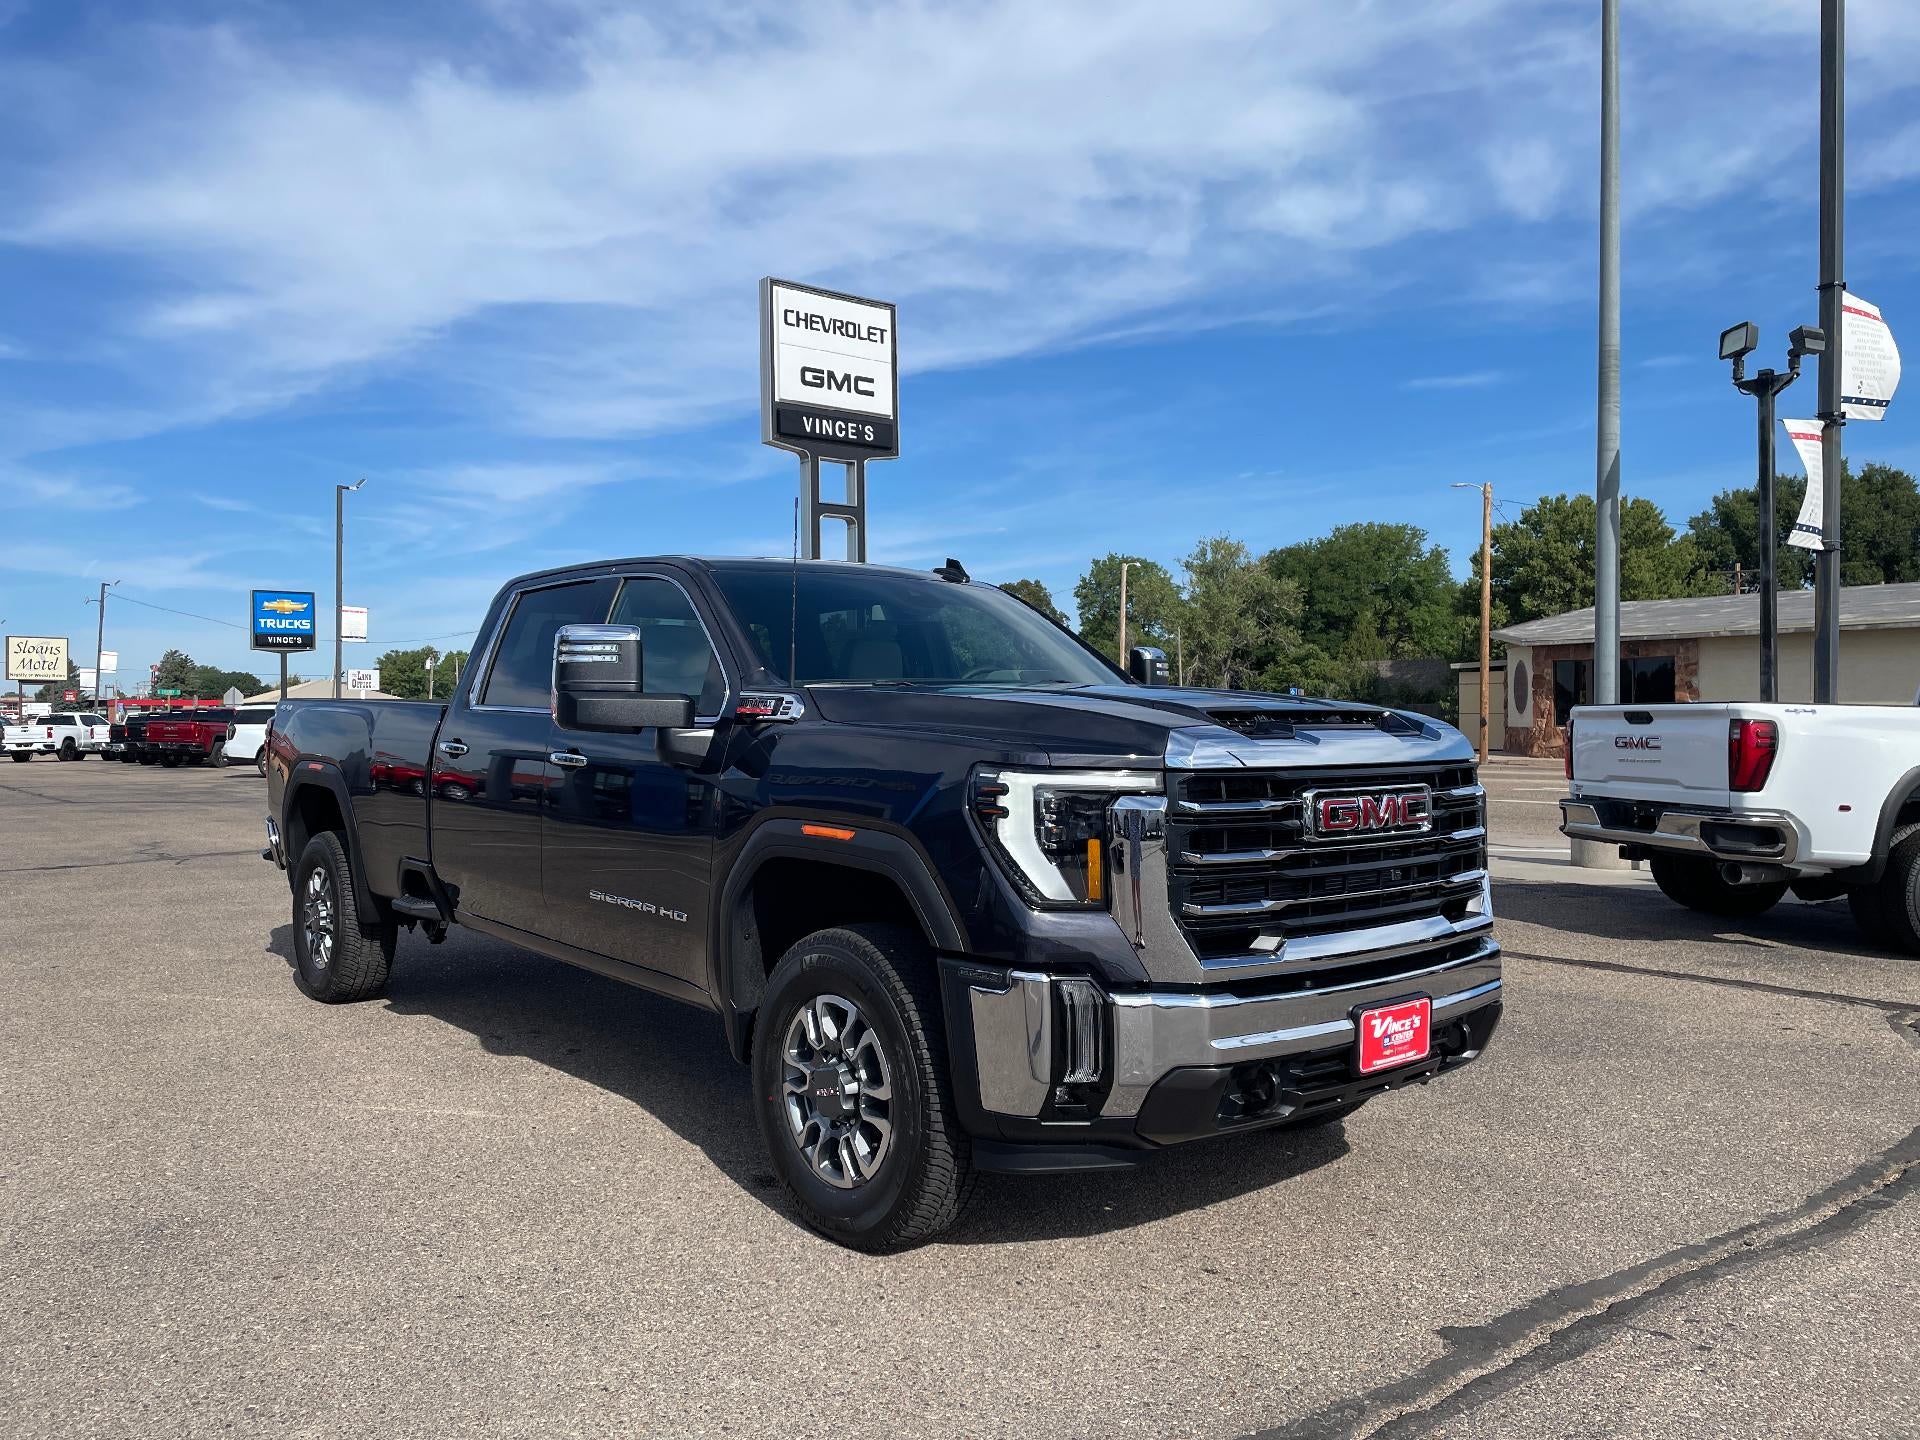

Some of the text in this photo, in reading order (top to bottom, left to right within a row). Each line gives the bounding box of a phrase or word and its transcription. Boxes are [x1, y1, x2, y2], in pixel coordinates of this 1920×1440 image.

[783, 308, 887, 344] CHEVROLET
[800, 366, 875, 397] GMC
[803, 416, 874, 441] VINCE'S
[258, 618, 311, 630] TRUCKS
[13, 640, 61, 656] Sloans
[16, 657, 59, 671] Motel
[1615, 736, 1662, 750] GMC
[1317, 794, 1430, 832] GMC
[659, 906, 688, 922] HD
[1370, 1014, 1421, 1039] VINCE'S
